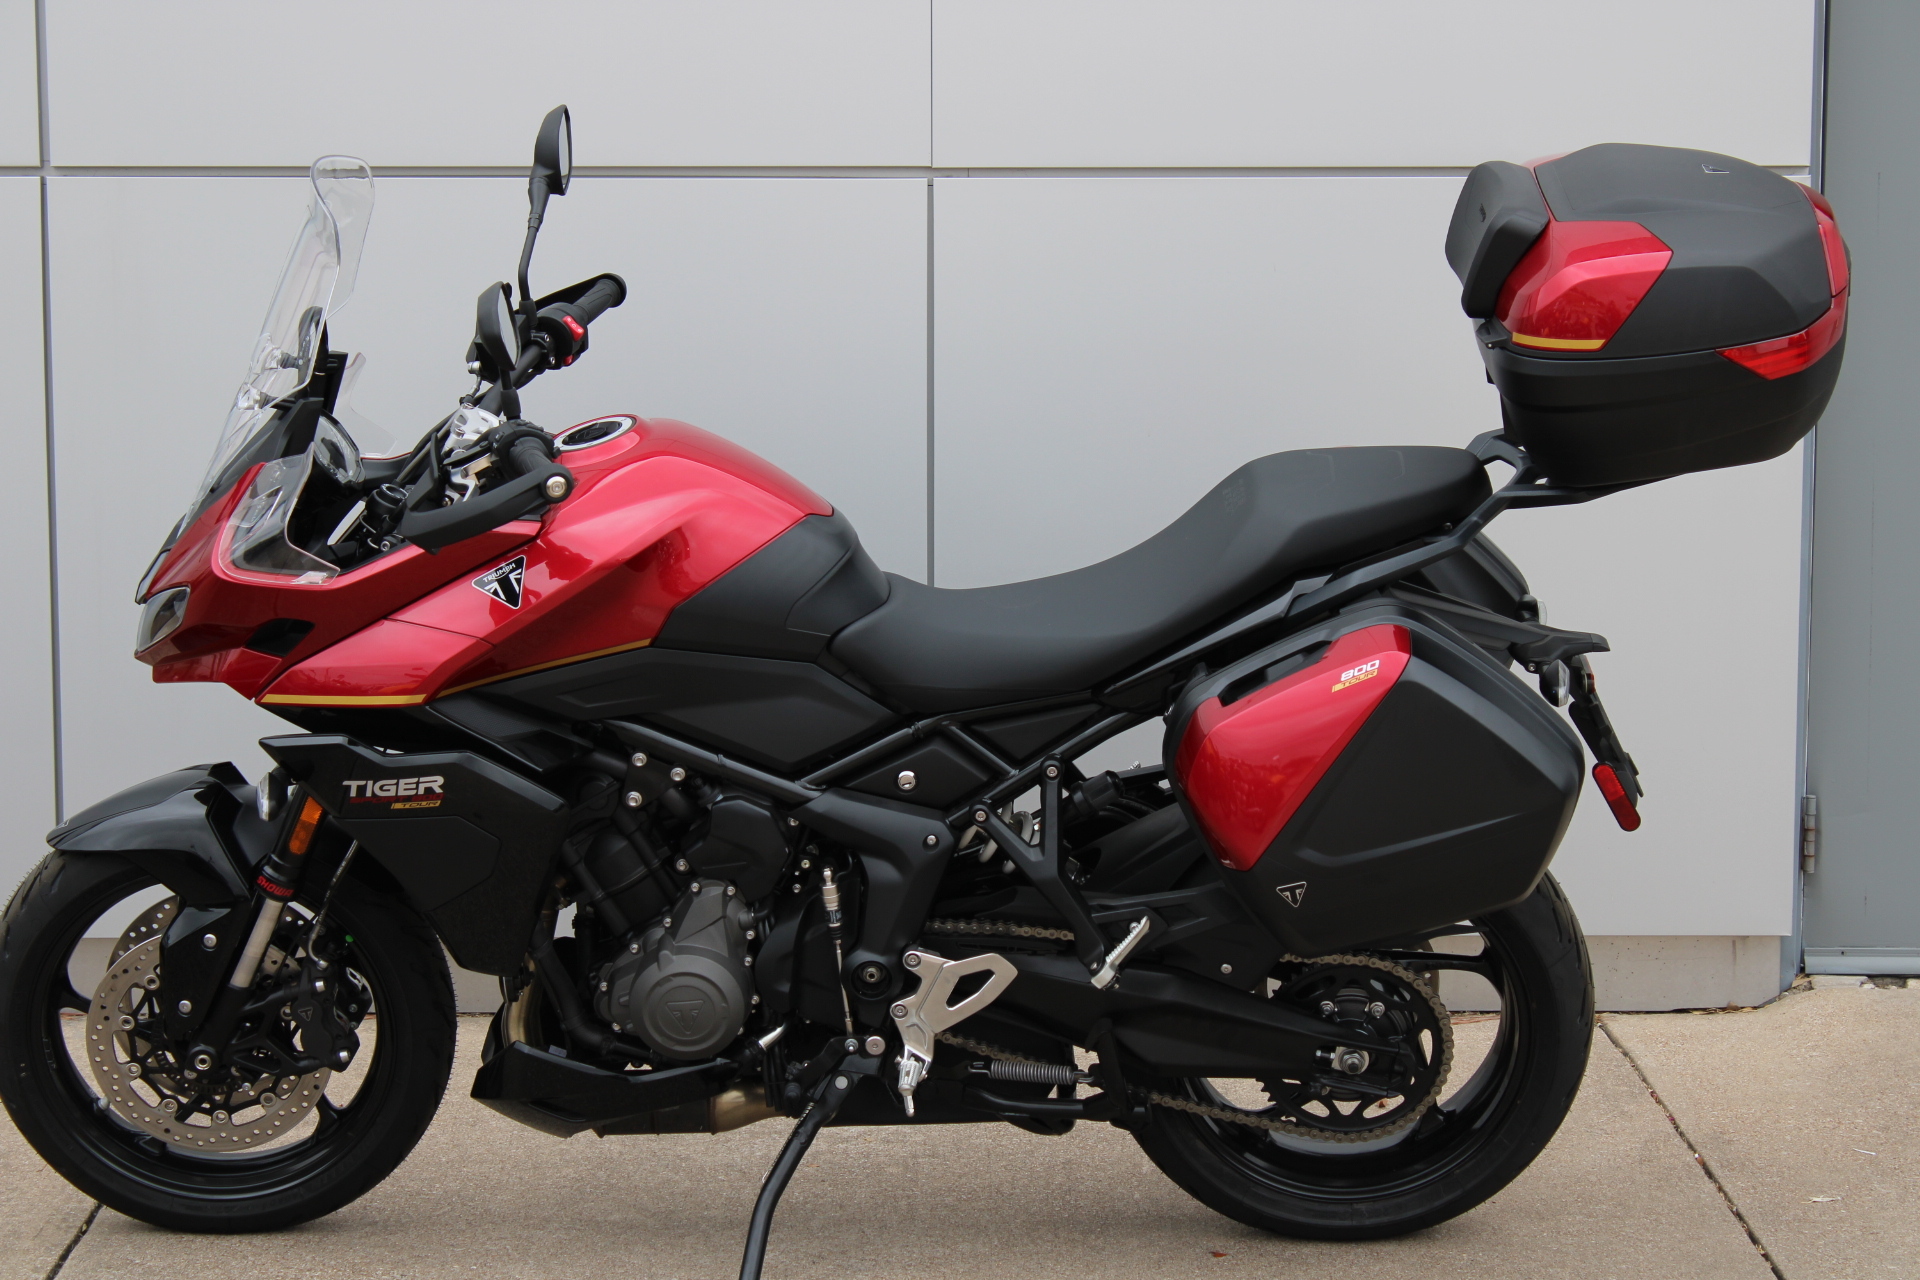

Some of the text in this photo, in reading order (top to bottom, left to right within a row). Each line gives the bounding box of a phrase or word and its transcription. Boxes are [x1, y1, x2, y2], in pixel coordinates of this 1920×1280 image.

[482, 562, 516, 583] TRIUMPH
[1340, 659, 1380, 682] 800
[1341, 670, 1376, 687] TOUR
[342, 775, 445, 798] TIGER
[349, 796, 408, 804] SPORT
[400, 801, 439, 809] TOUR
[256, 875, 294, 897] SHOWA
